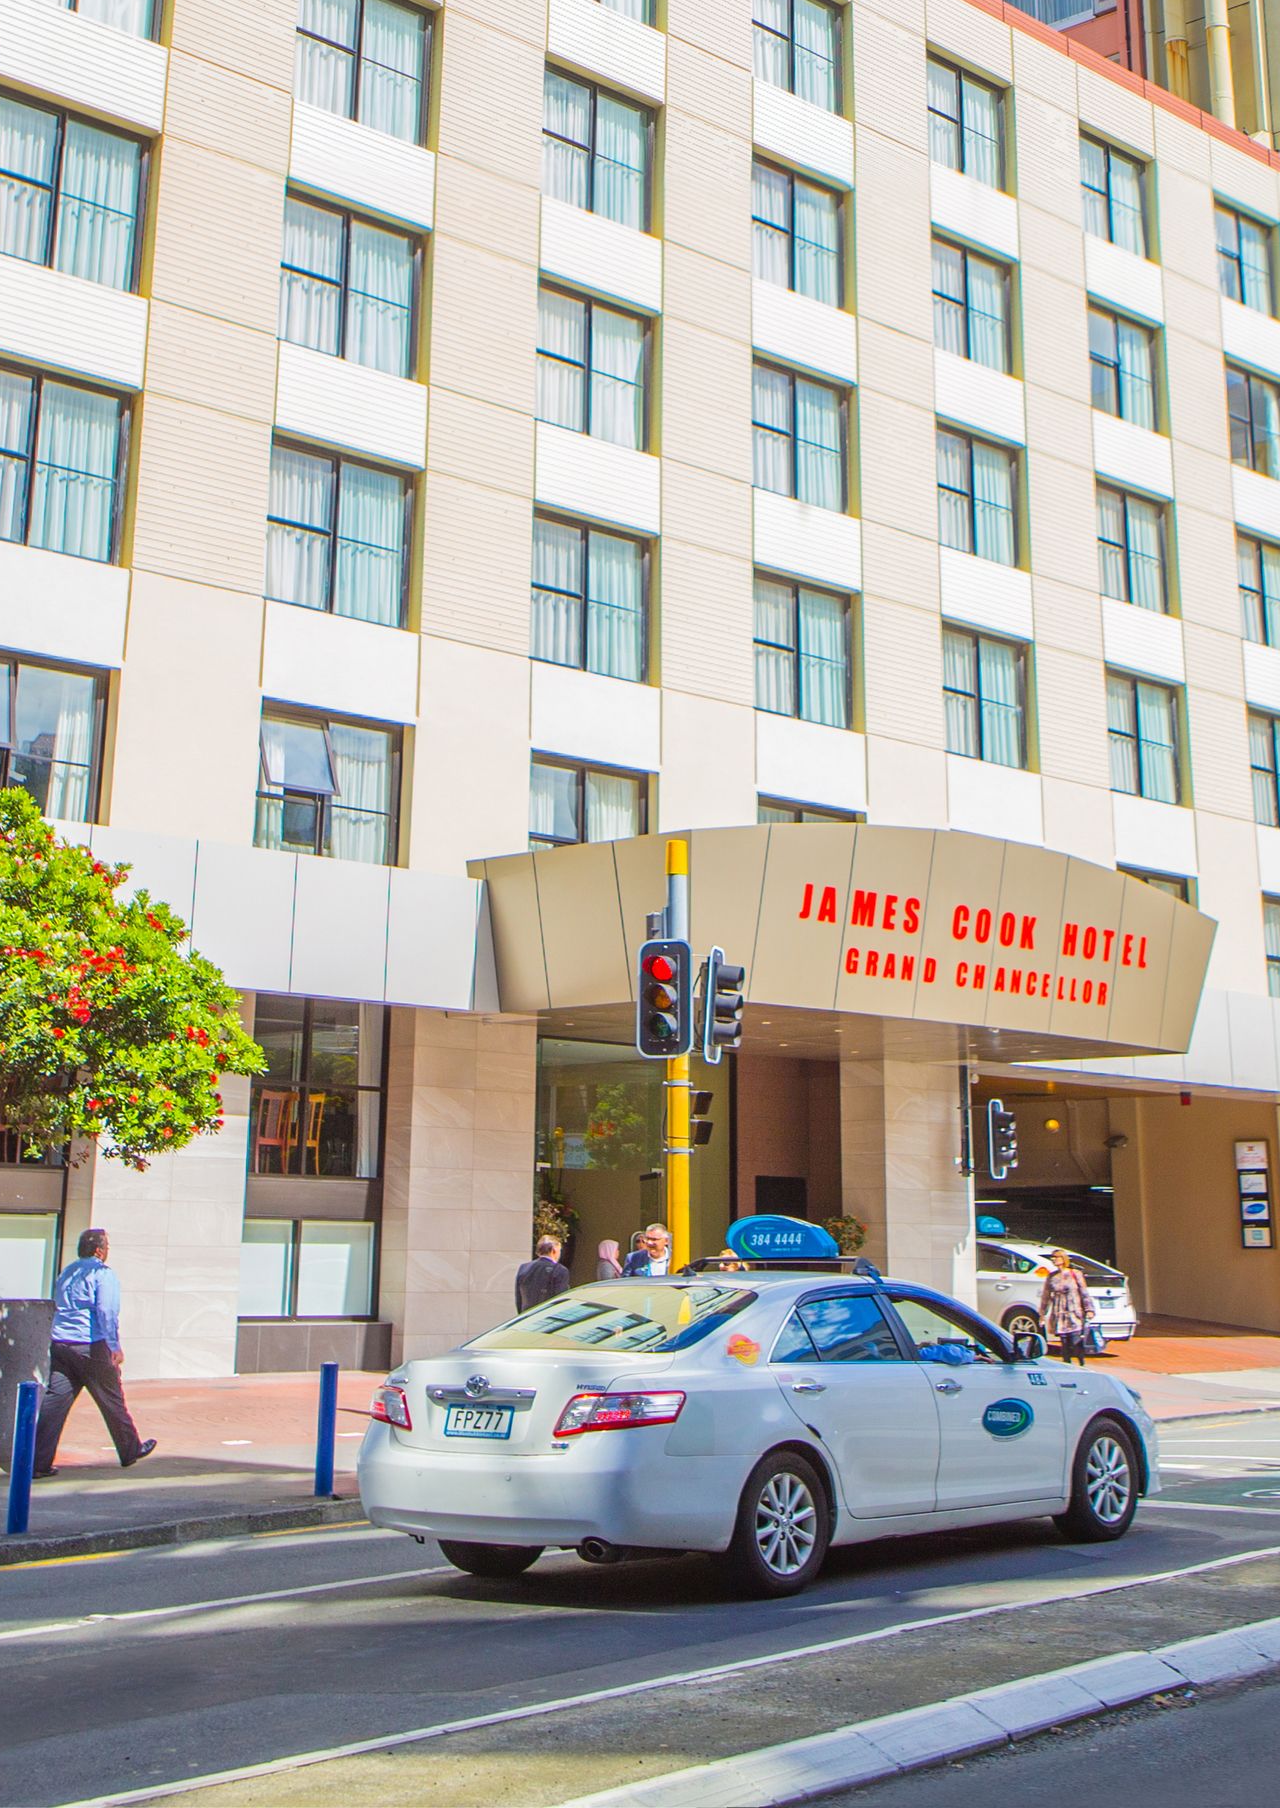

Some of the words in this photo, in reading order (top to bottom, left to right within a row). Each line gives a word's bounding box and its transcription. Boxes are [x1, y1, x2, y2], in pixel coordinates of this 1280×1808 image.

[798, 883, 921, 935] JAMES
[951, 904, 1038, 952] COOK
[1062, 922, 1149, 969] HOTEL
[845, 947, 938, 983] GRAND
[955, 961, 1109, 1006] CHANCELLOR
[750, 1234, 771, 1246] 384
[774, 1233, 802, 1245] 4444
[453, 1409, 505, 1431] FPZ77
